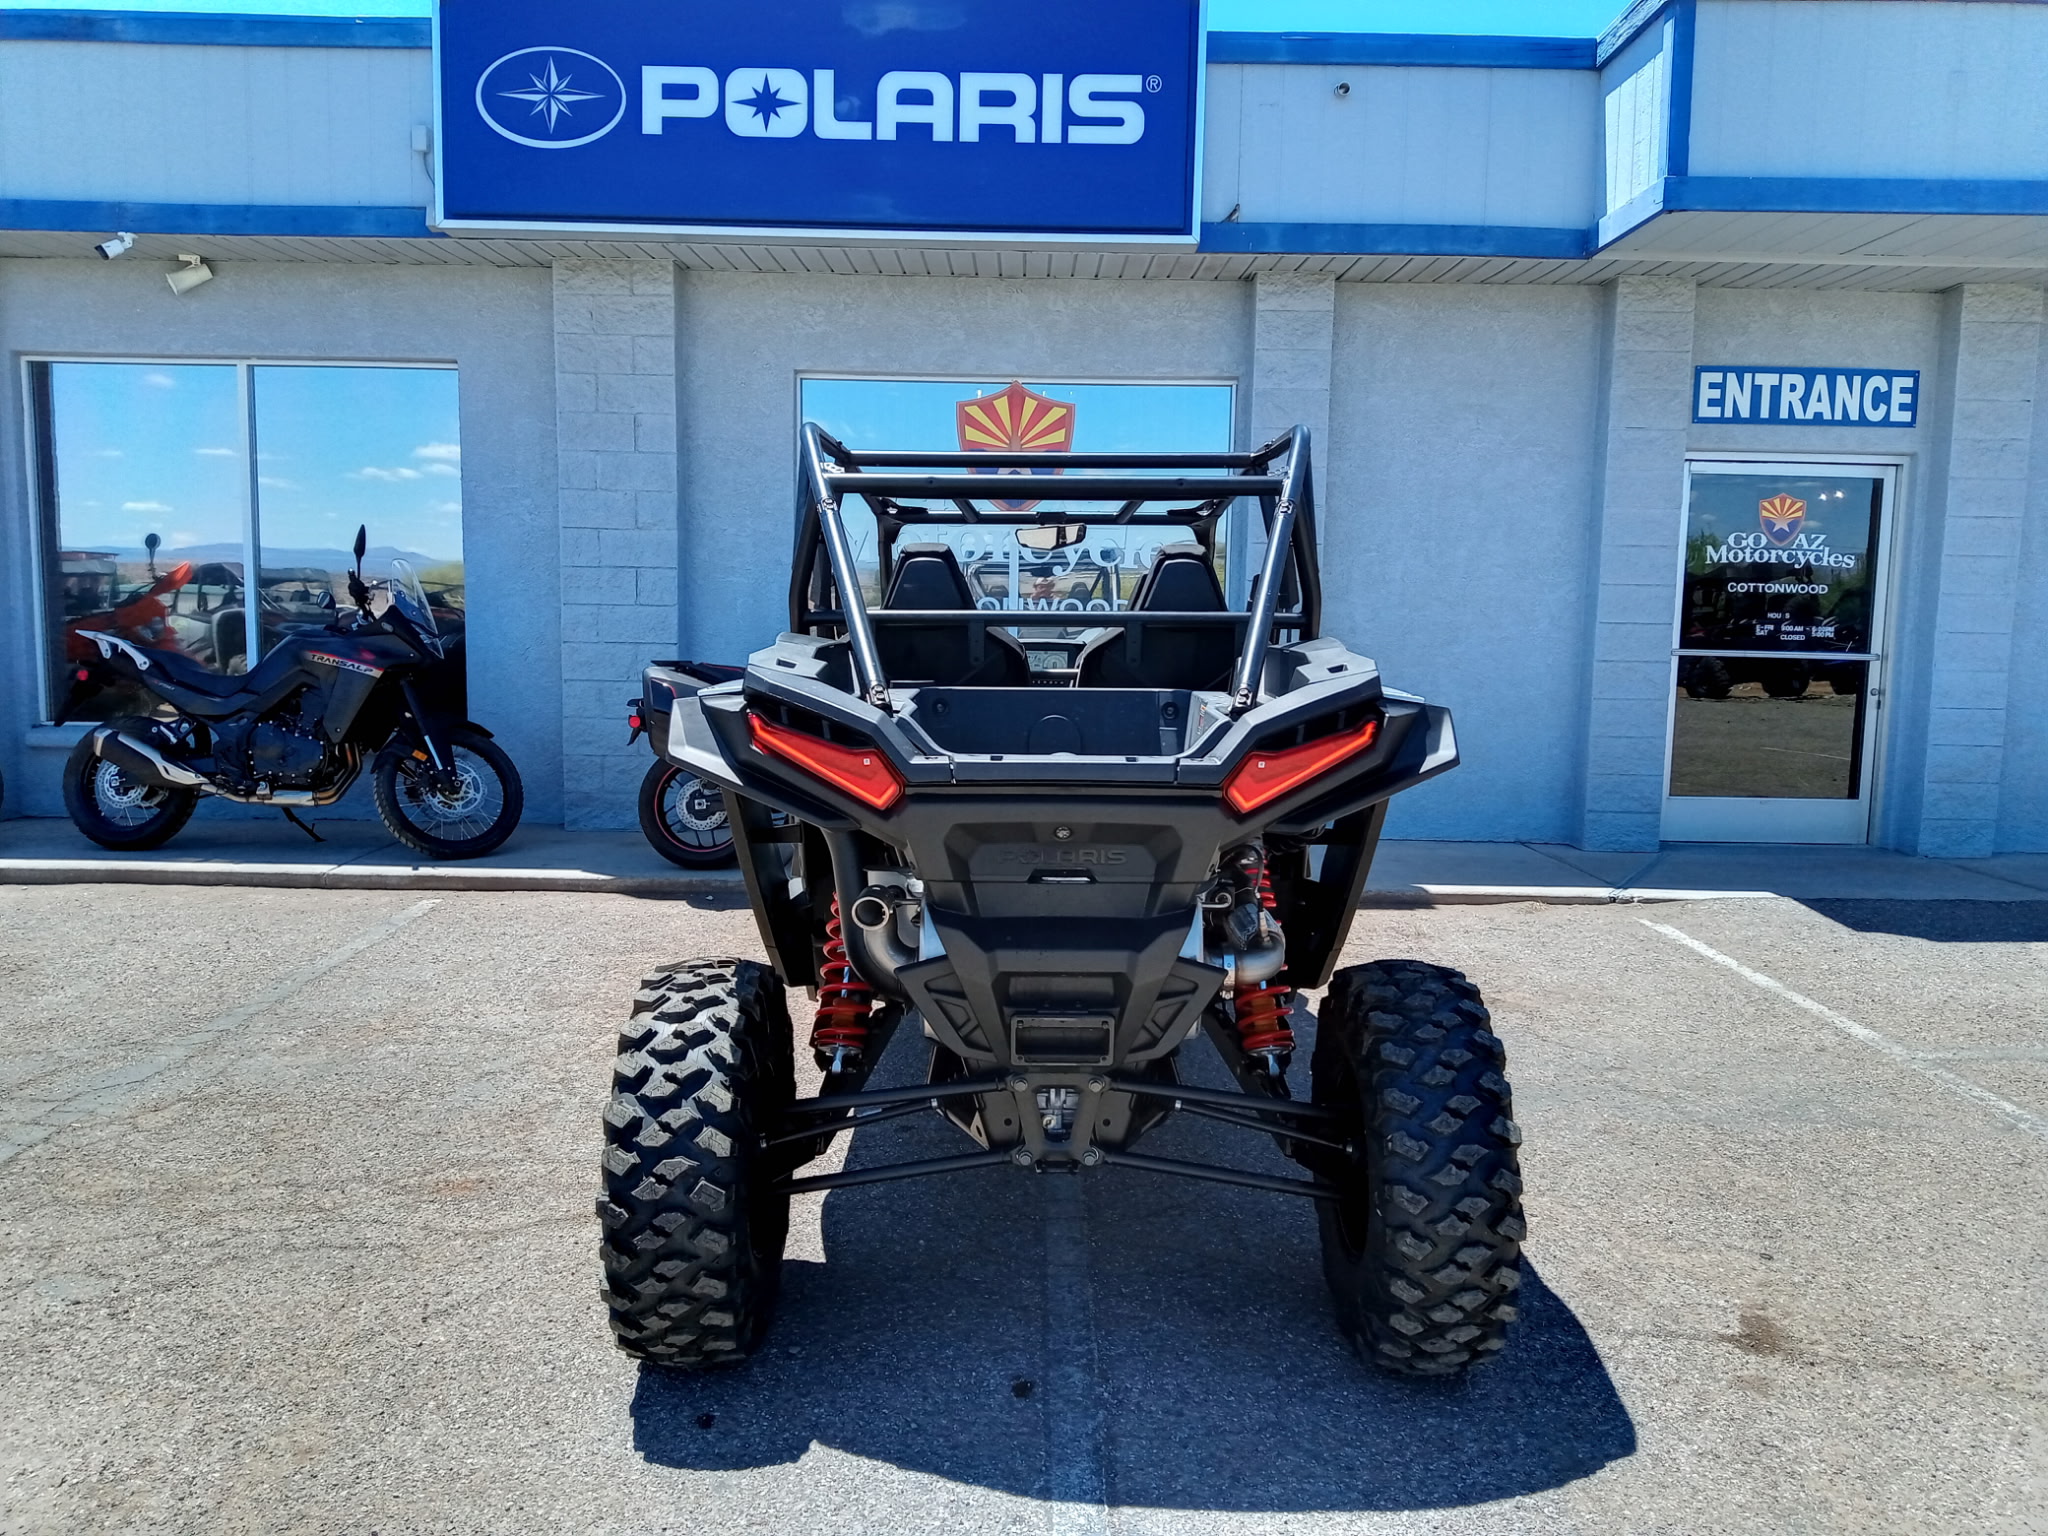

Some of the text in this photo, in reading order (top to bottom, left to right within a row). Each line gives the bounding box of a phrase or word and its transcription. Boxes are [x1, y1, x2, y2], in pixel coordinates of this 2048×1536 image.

[1698, 372, 1914, 422] ENTRANCE
[1727, 532, 1827, 550] GO AZ
[1705, 544, 1856, 569] Motorcycles
[1727, 582, 1829, 595] COTTONWOOD
[311, 653, 374, 673] TRANSALP
